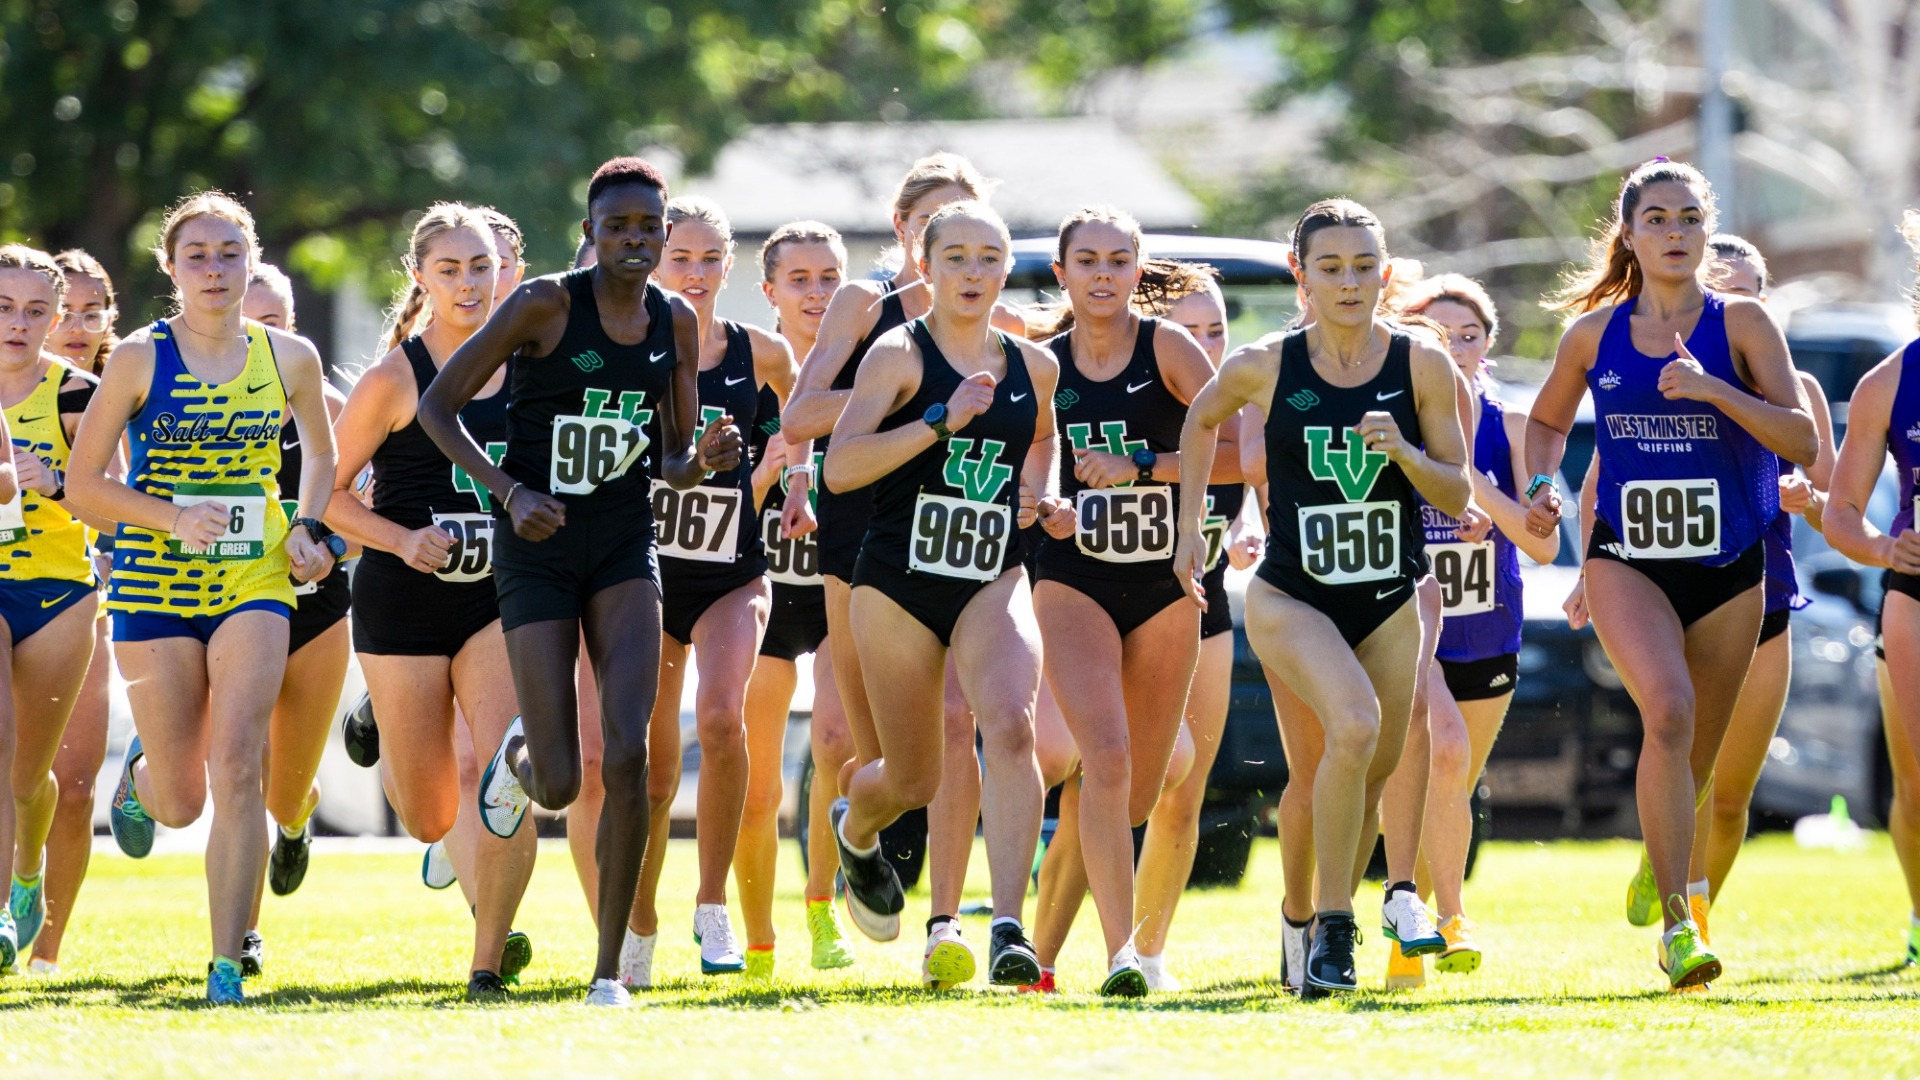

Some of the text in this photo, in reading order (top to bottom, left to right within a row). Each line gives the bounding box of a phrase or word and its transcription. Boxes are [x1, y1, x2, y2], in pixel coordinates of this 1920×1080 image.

[1598, 376, 1621, 387] RMAC
[152, 411, 280, 443] Salt Lake
[1605, 414, 1718, 440] WESTMINSTER
[1638, 442, 1692, 453] GRIFFINS
[942, 437, 1013, 503] UV
[437, 519, 496, 575] 95
[652, 487, 738, 553] 967
[767, 517, 818, 577] 96
[915, 501, 1005, 572] 968
[1081, 493, 1169, 554] 953
[1305, 508, 1394, 576] 956
[1626, 487, 1715, 549] 995
[220, 542, 251, 555] GREEN
[1427, 548, 1490, 608] 94
